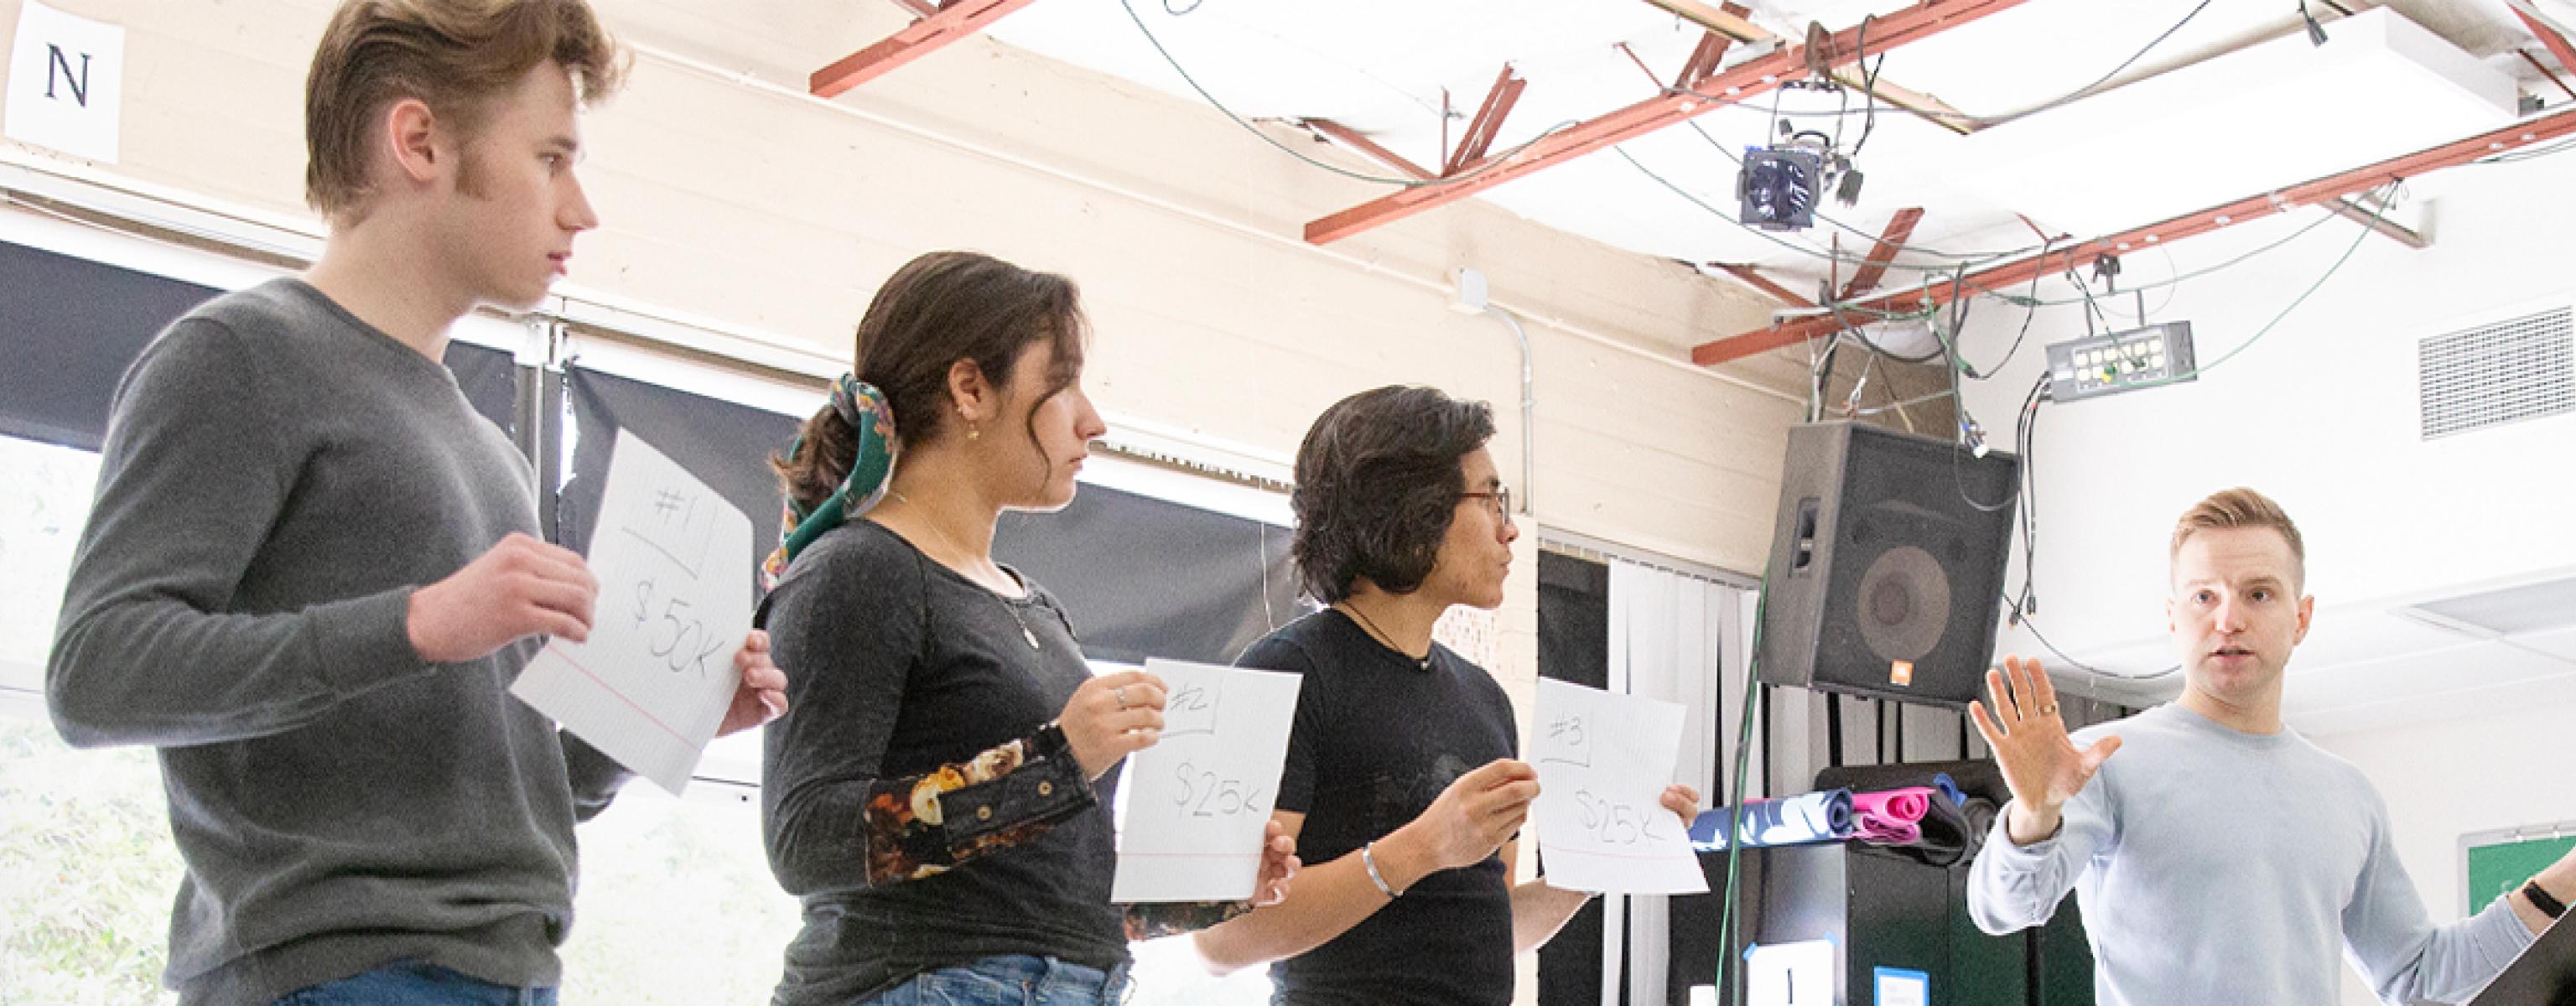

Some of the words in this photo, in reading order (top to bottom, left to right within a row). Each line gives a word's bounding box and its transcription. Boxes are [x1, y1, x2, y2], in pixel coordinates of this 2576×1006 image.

[44, 43, 92, 109] N
[654, 489, 699, 533] #1
[1170, 681, 1208, 713] #2
[1549, 712, 1584, 746] #3
